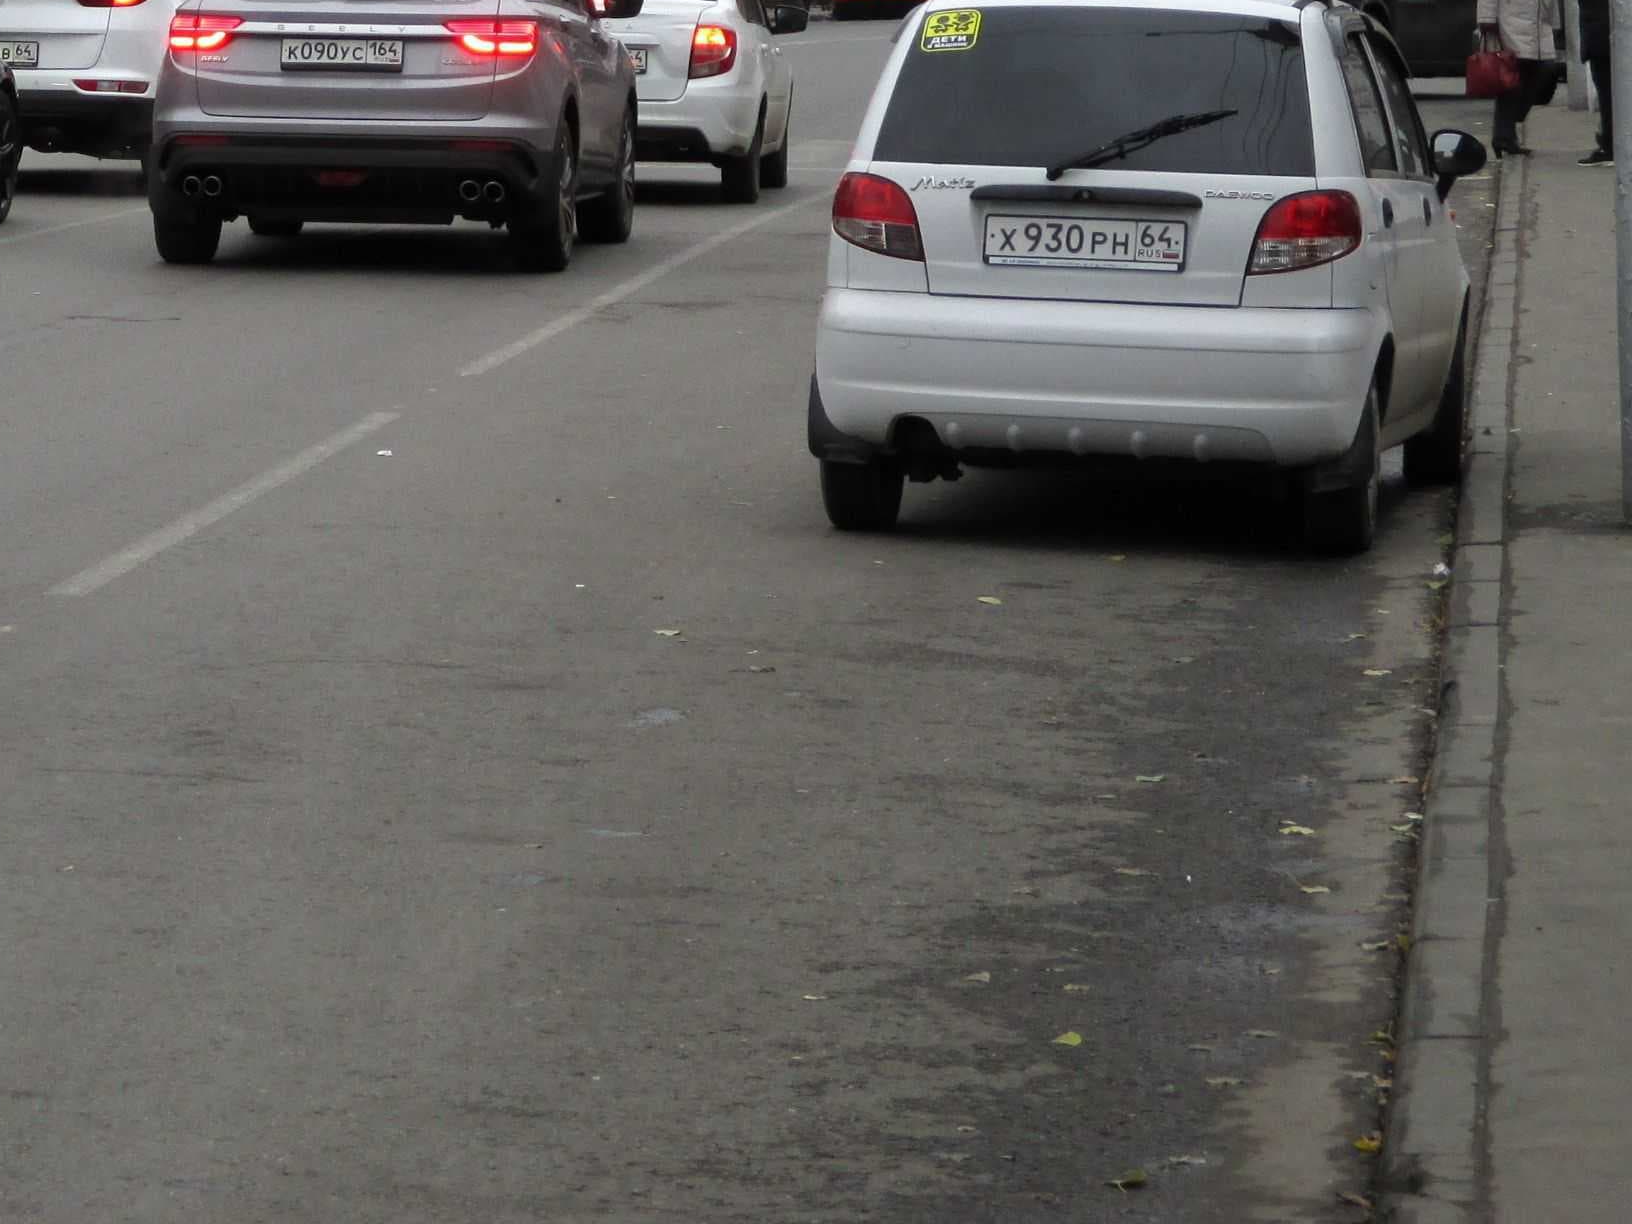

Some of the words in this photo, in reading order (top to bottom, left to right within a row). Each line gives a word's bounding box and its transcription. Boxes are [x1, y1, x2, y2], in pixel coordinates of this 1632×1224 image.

[15, 44, 32, 57] 64
[287, 41, 365, 62] К090УС
[370, 42, 398, 57] 164
[909, 175, 978, 192] Matiz
[1205, 189, 1274, 201] DAEWOO
[999, 223, 1130, 256] Х930РН
[1139, 223, 1172, 248] 64
[1137, 247, 1162, 259] RUS
